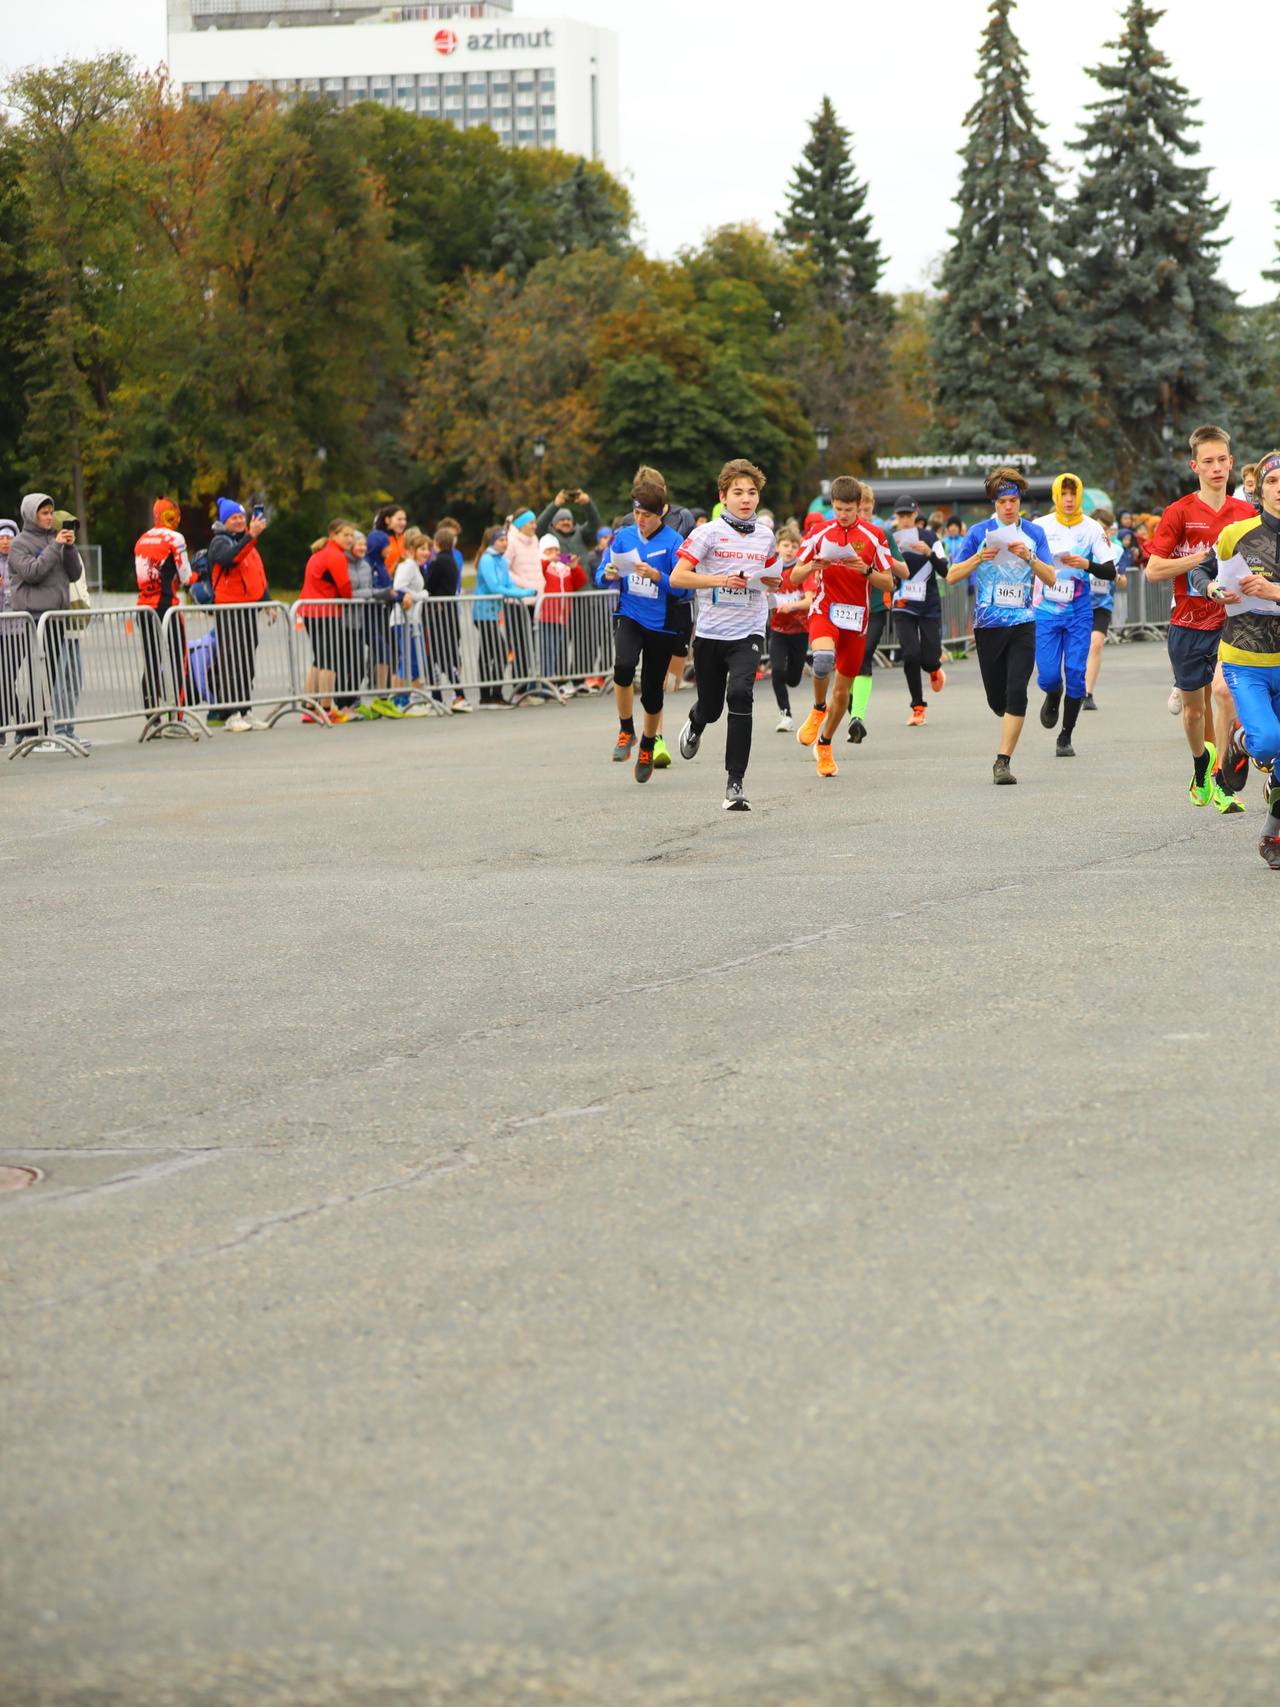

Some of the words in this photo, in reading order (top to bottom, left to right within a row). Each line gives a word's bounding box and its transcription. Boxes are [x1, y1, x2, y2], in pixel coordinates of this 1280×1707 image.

[467, 27, 553, 51] azimut
[876, 455, 970, 469] УЛЬЯНОВСКАЯ
[976, 454, 1037, 466] ОБЛАСТЬ
[714, 550, 743, 560] NORD
[631, 575, 653, 587] 321.1
[996, 588, 1023, 599] 305.1
[833, 609, 859, 621] 322.1
